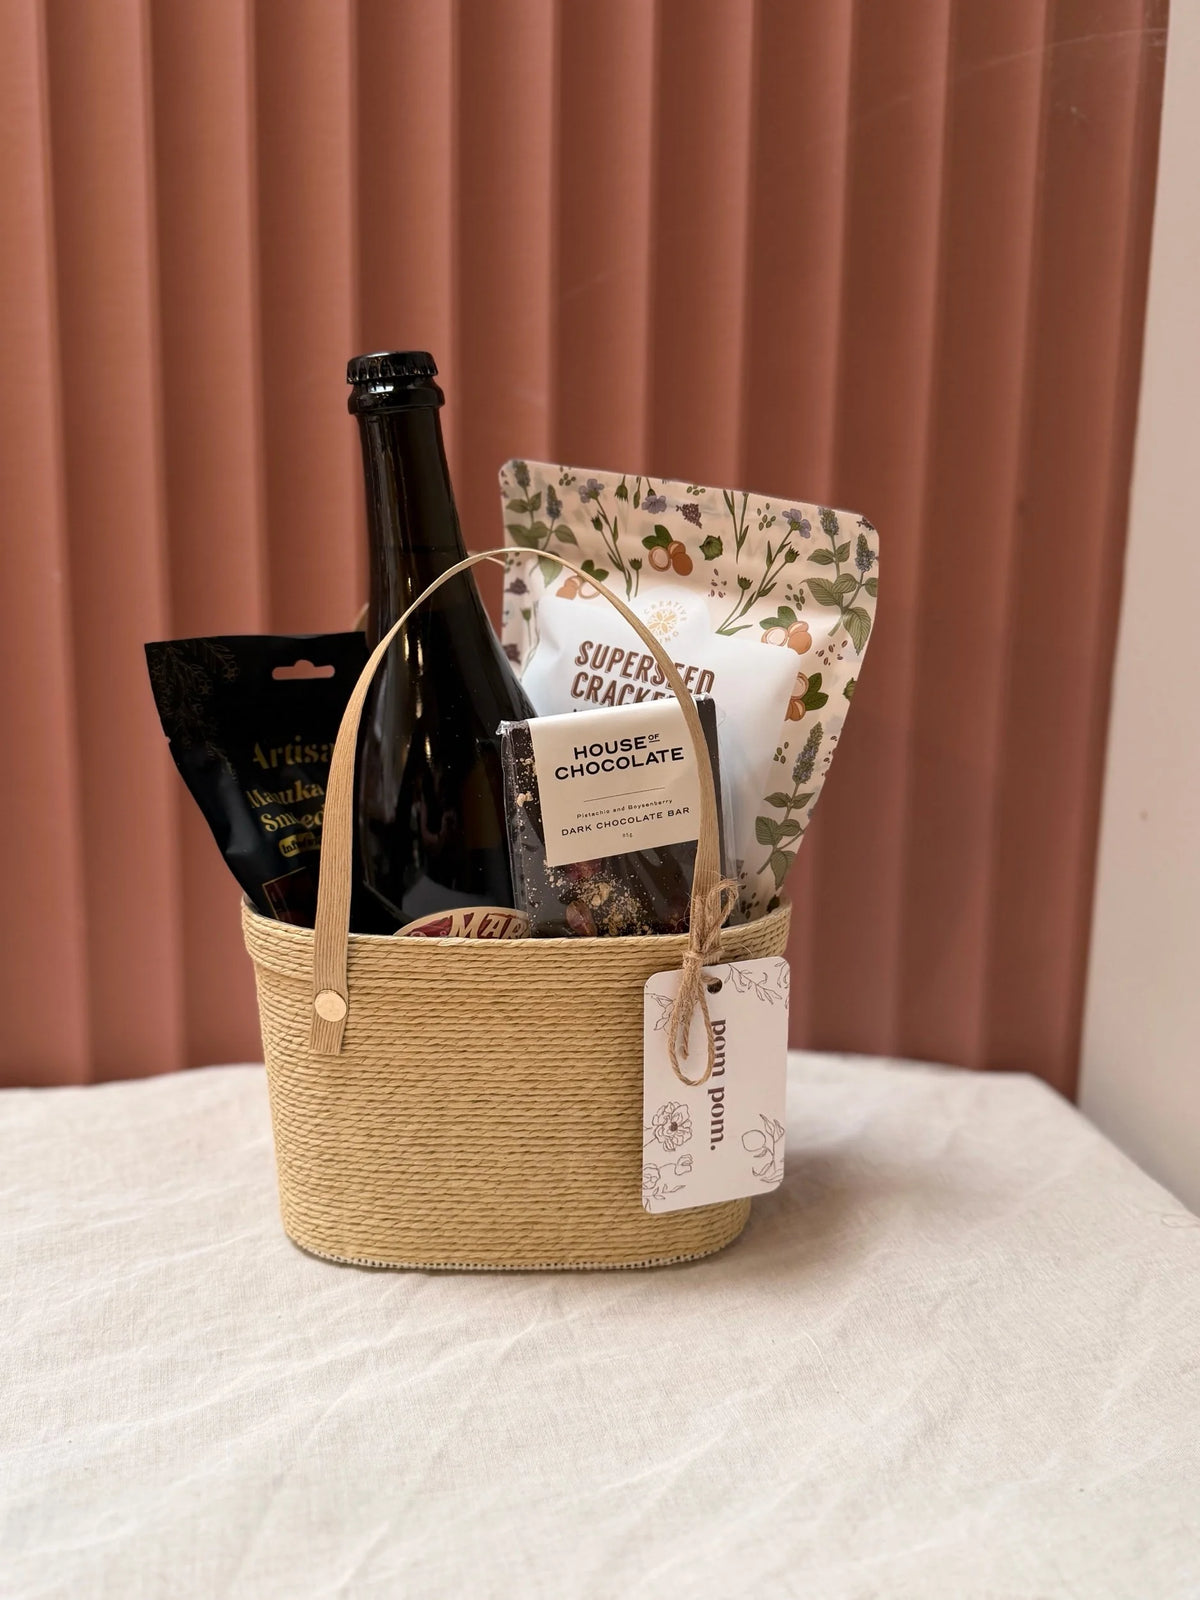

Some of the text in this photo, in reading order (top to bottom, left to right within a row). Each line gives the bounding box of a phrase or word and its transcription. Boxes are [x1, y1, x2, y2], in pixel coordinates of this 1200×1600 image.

[571, 671, 677, 706] CRACK
[252, 734, 335, 770] Artisa
[574, 733, 660, 760] HOUSE OF
[555, 747, 685, 780] CHOCOLATE
[561, 806, 691, 836] DARK CHOCOLATE BAR
[576, 799, 673, 819] Pistachio and Boysenberry
[707, 1019, 727, 1151] pom pom.
